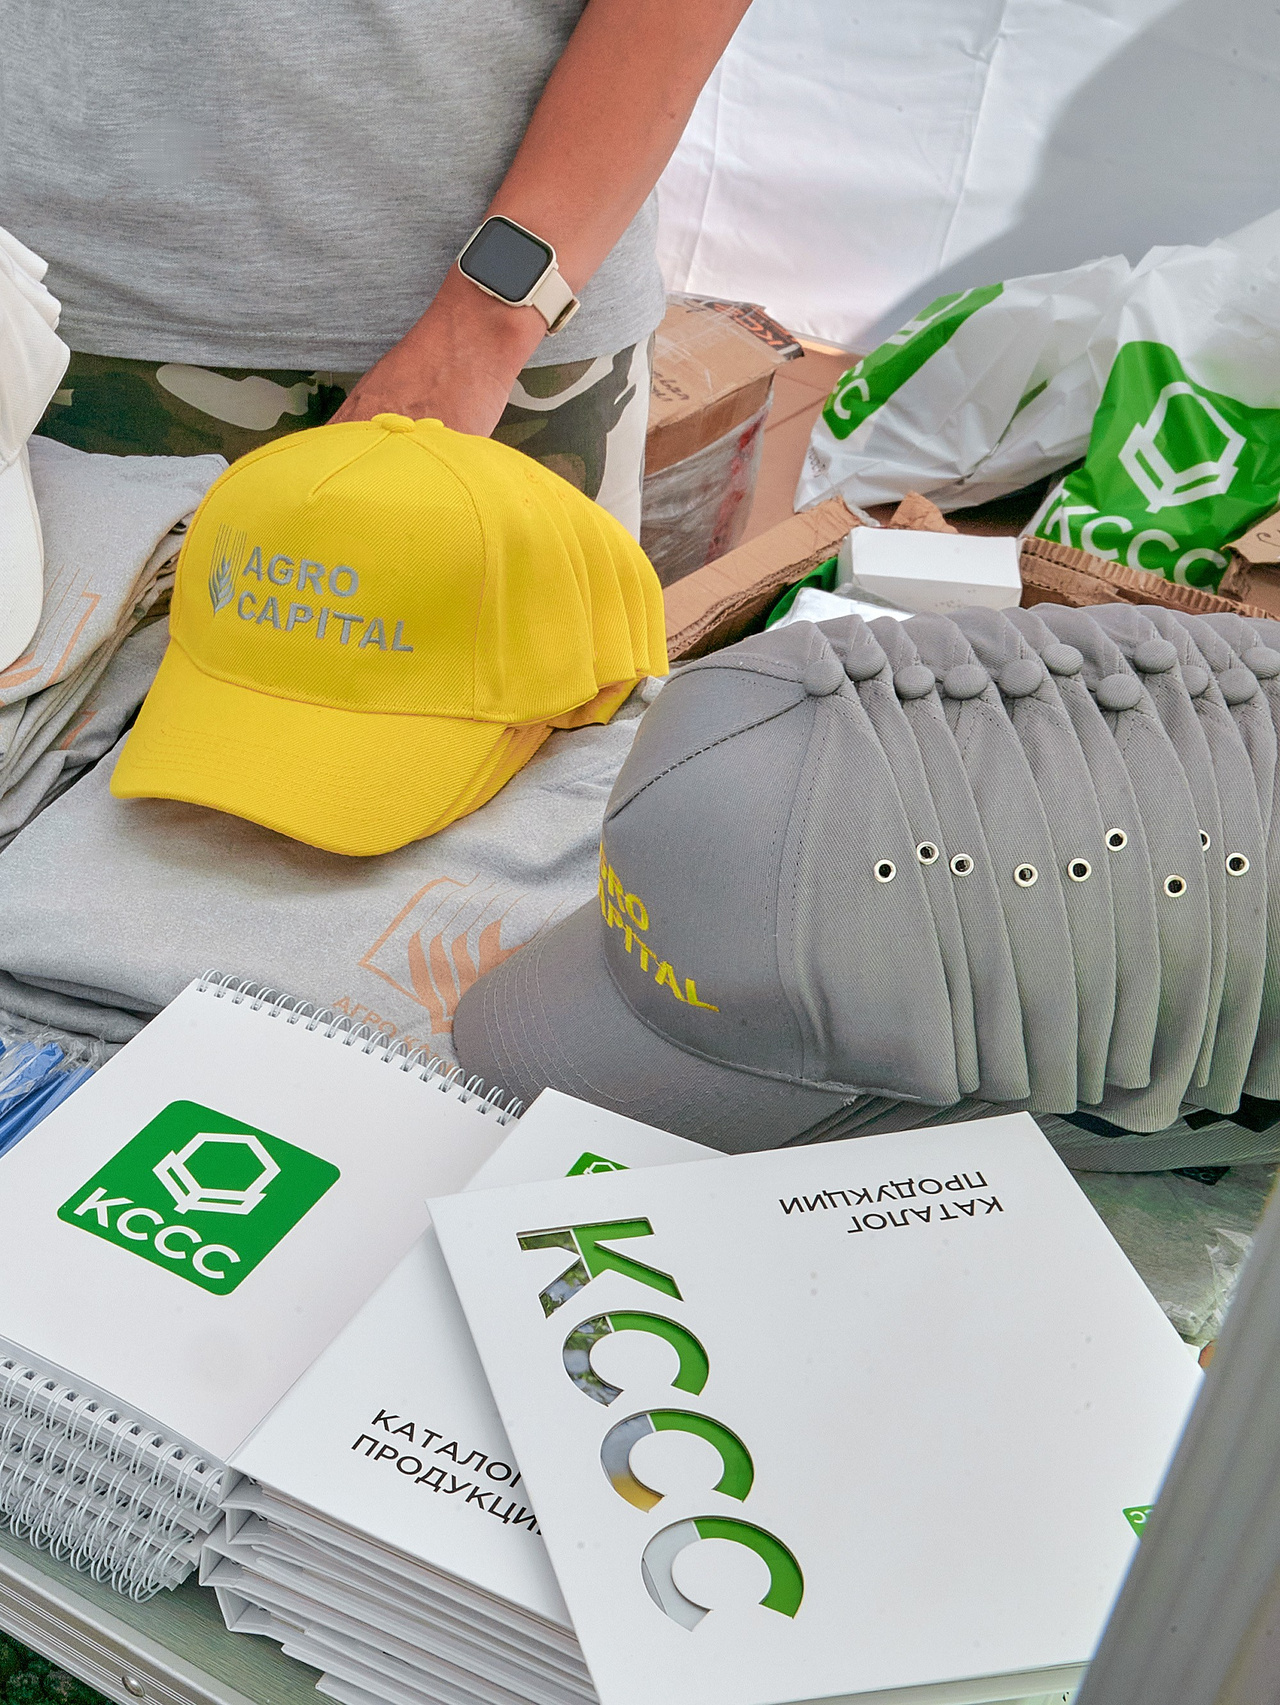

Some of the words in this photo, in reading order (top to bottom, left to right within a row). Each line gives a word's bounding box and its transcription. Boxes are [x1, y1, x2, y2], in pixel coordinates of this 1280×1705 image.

[242, 546, 359, 598] AGRO
[237, 590, 414, 653] CAPITAL
[598, 877, 720, 1013] PITAL
[778, 1171, 989, 1215] ПРОДУКЦИИ
[847, 1196, 1004, 1233] КАТАЛОГ
[350, 1433, 542, 1536] ПРОДУКЦИ
